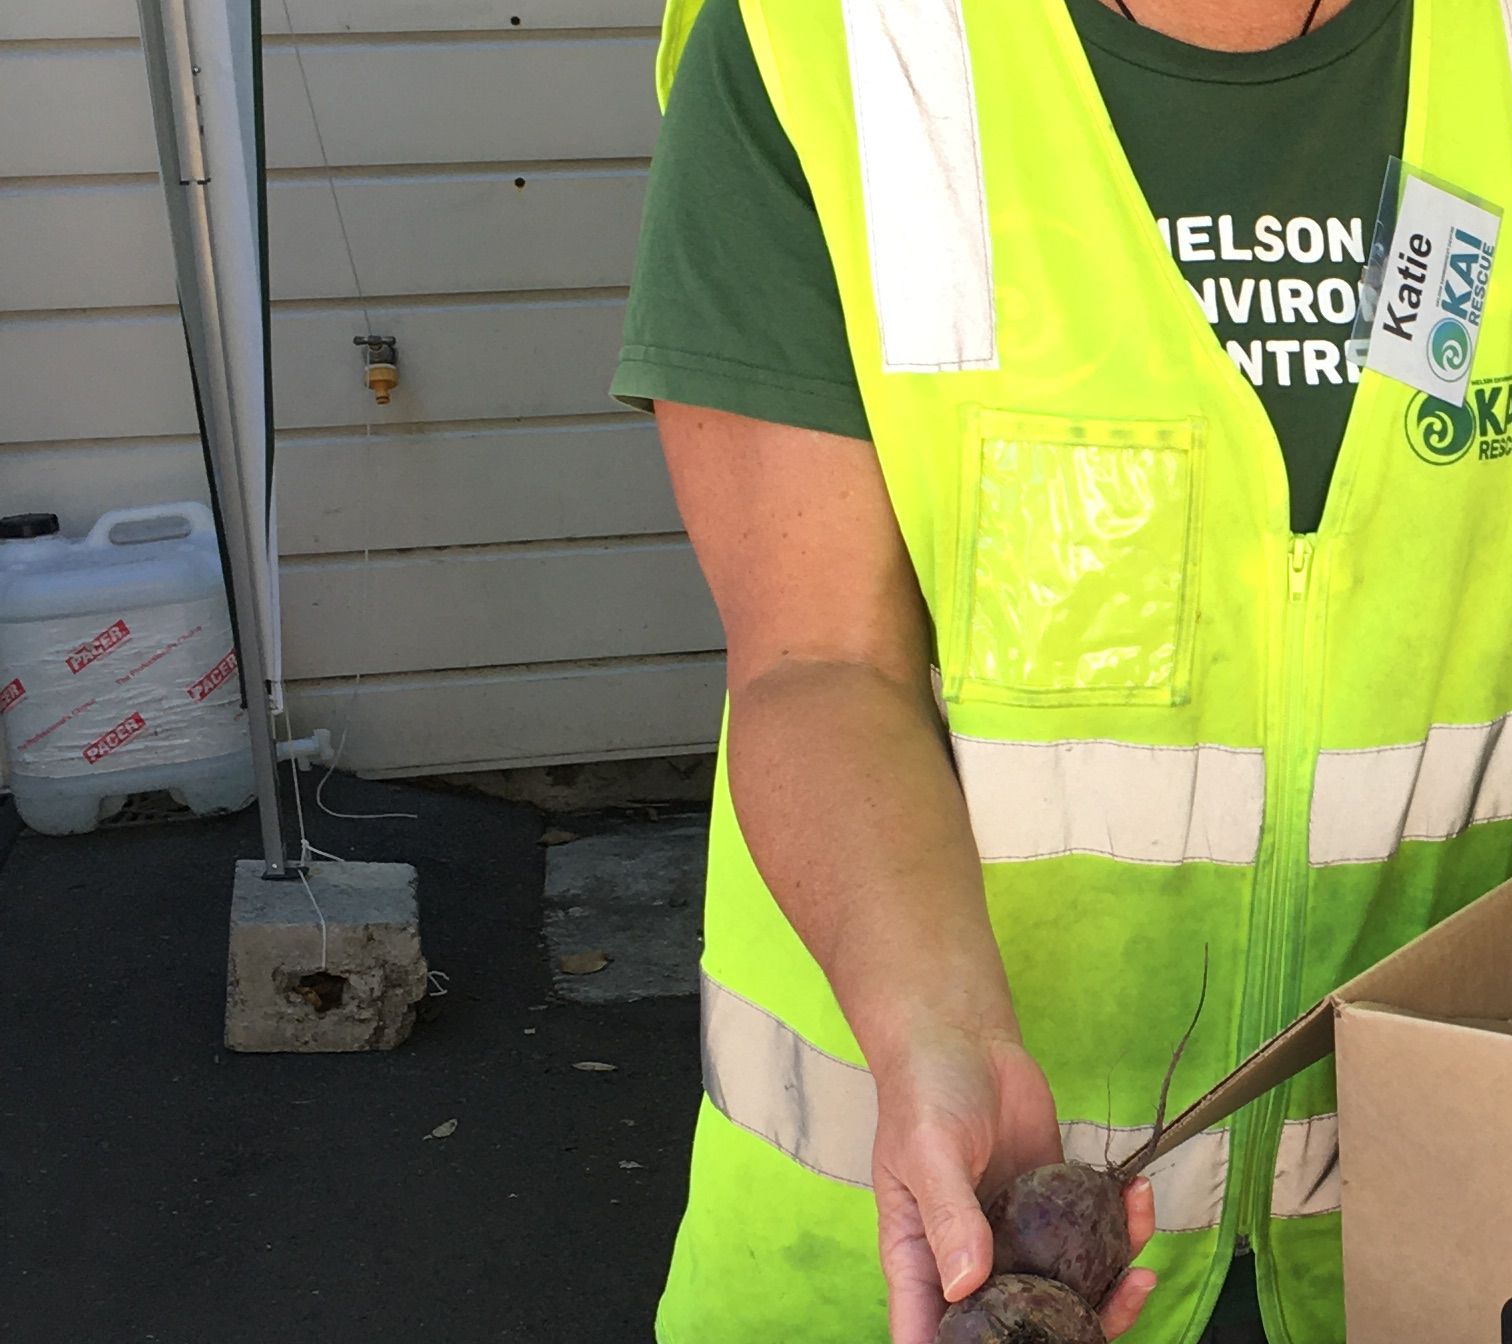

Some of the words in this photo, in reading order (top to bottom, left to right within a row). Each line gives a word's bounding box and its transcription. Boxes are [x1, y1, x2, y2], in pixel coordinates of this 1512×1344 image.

[1184, 277, 1374, 324] NVIRO
[1383, 233, 1432, 341] Katie
[1441, 228, 1483, 320] KAI
[1468, 242, 1495, 327] RESCUE
